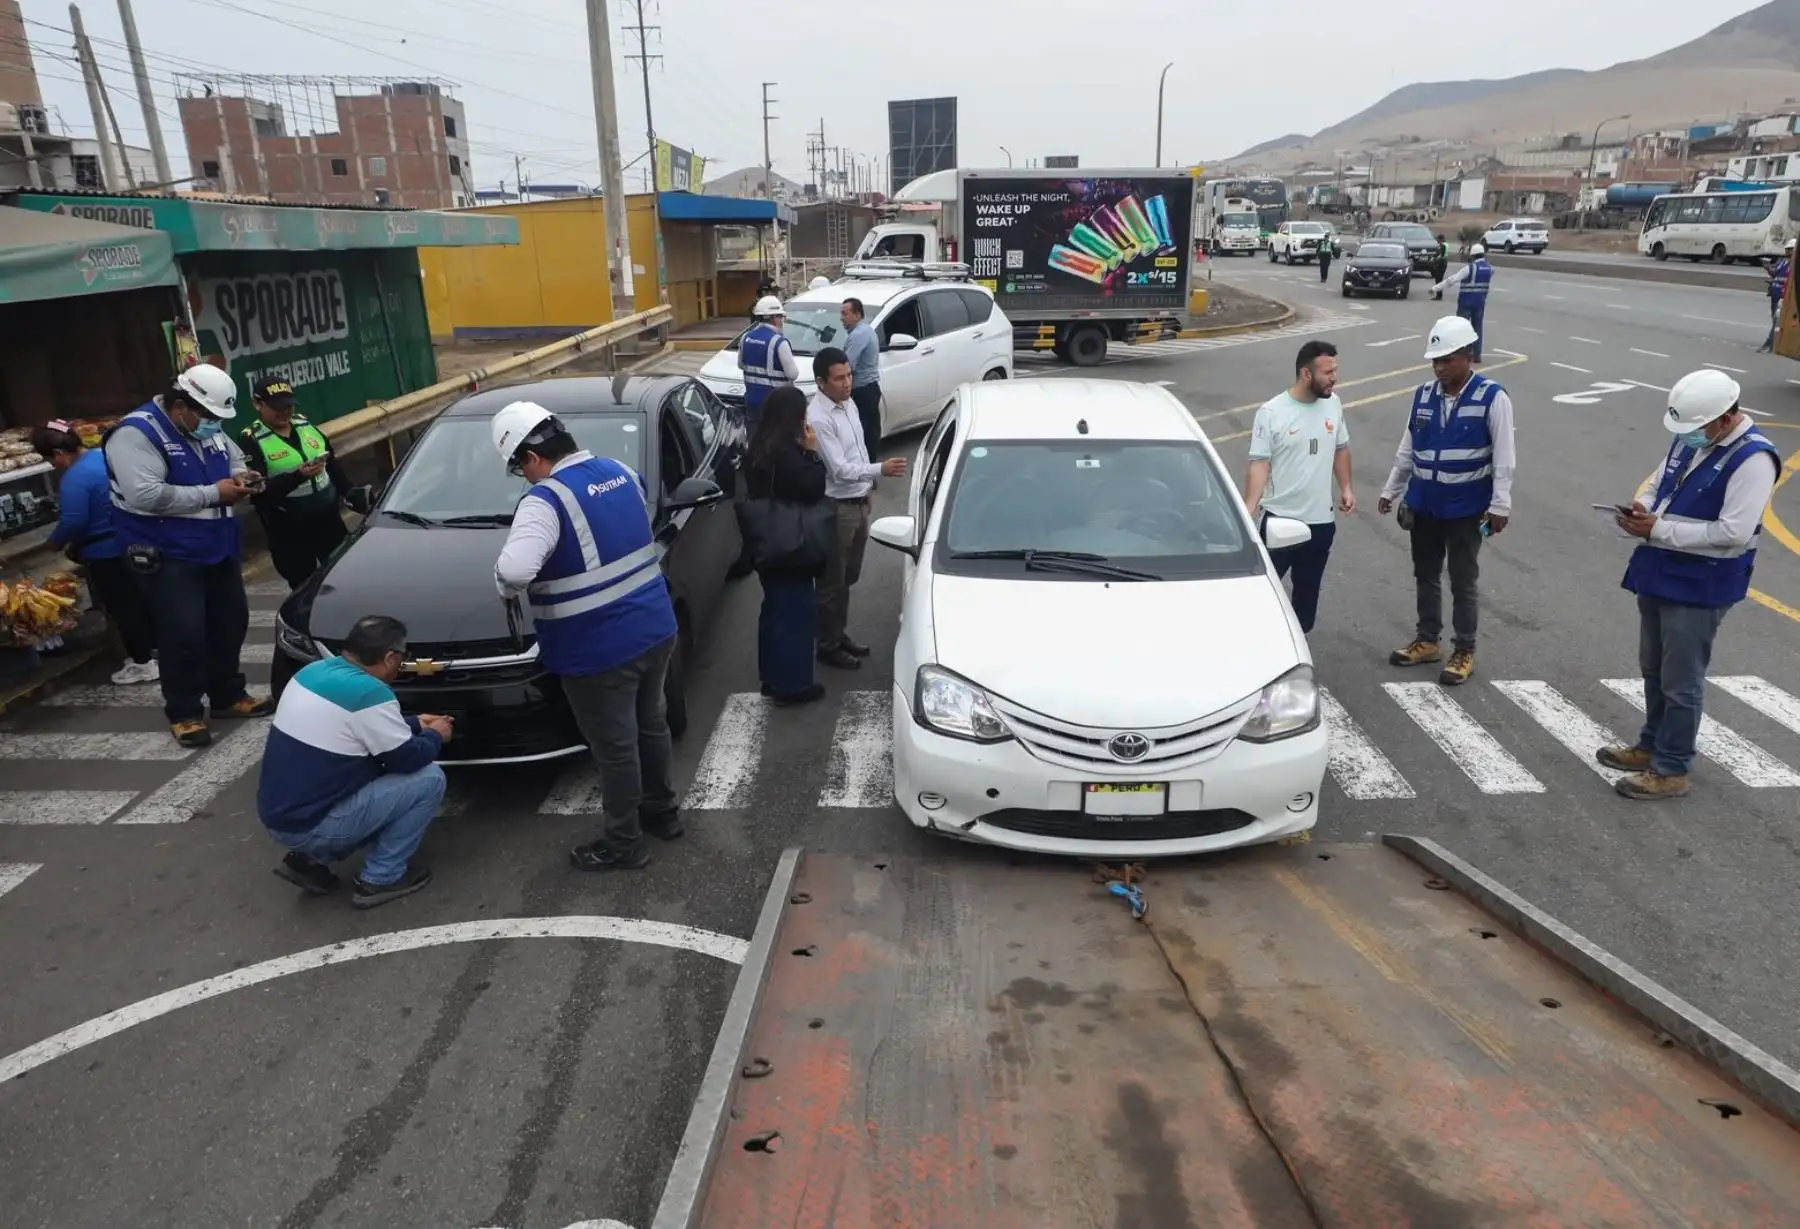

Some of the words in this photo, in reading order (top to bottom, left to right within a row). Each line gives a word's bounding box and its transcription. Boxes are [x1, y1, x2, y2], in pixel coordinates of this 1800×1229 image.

[1021, 193, 1039, 202] THE
[976, 205, 1012, 214] WAKE
[1014, 205, 1031, 214] UP
[215, 273, 346, 350] SPORADE
[325, 350, 351, 378] VALE
[1309, 438, 1318, 455] 10
